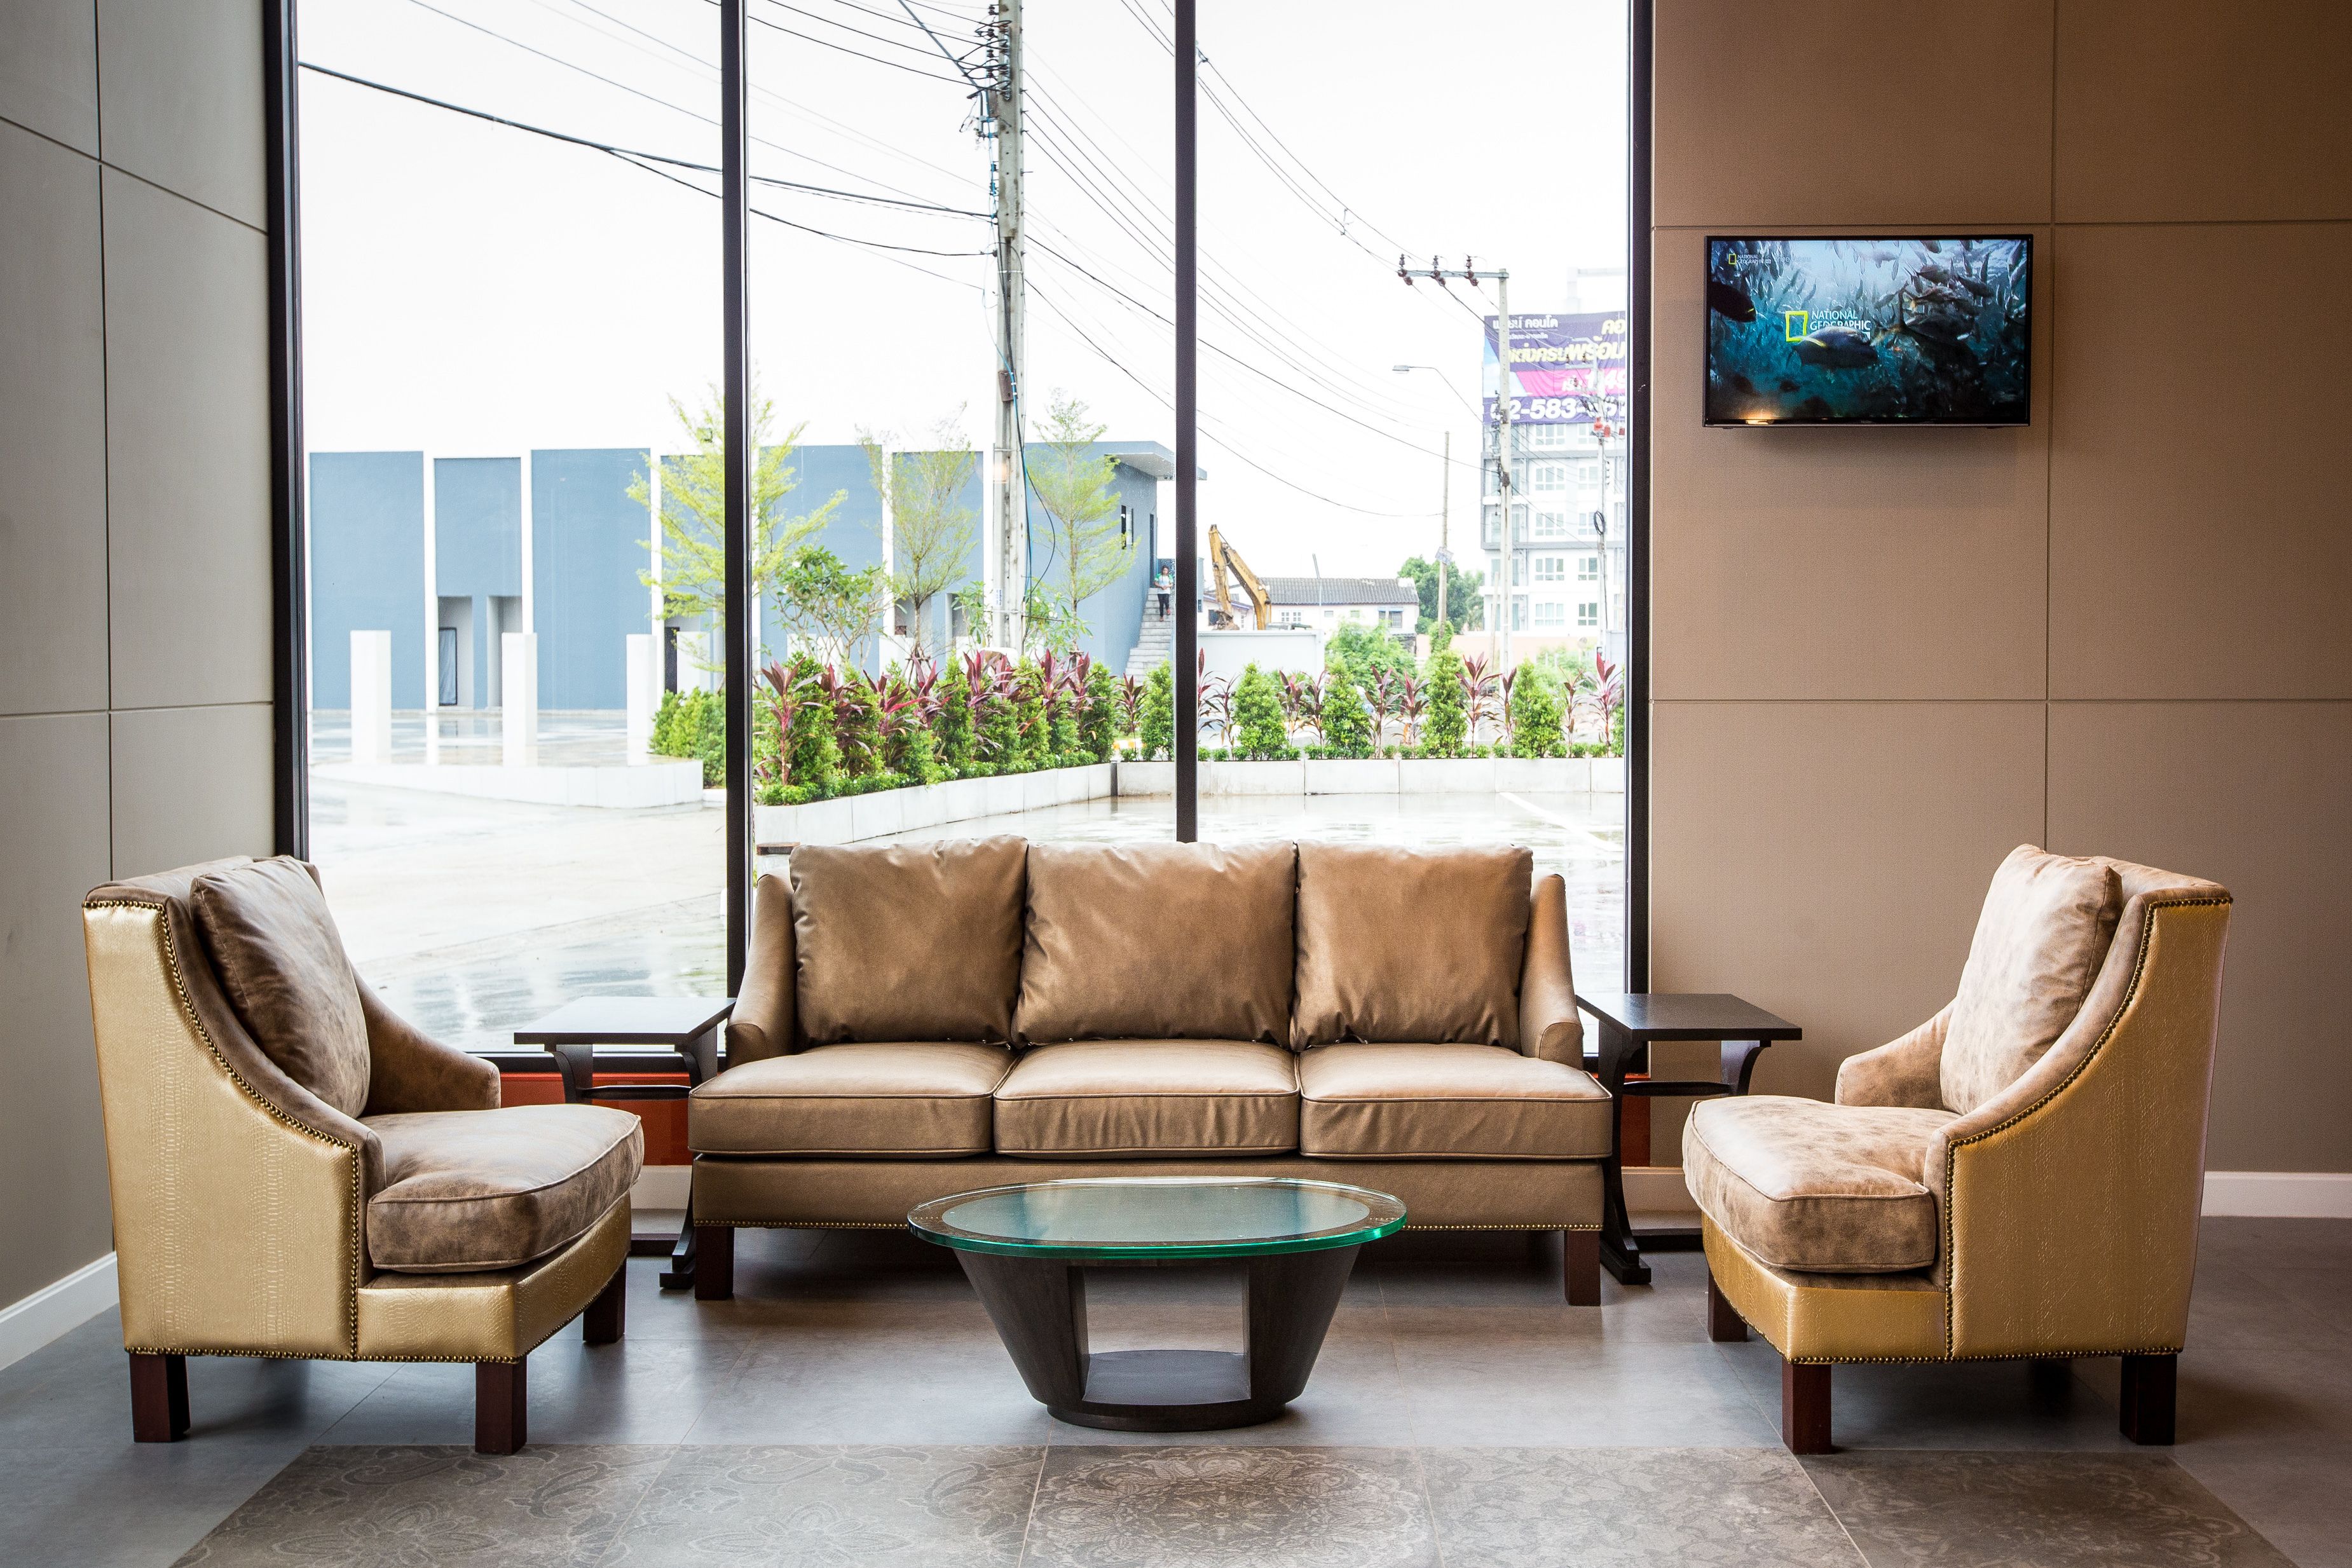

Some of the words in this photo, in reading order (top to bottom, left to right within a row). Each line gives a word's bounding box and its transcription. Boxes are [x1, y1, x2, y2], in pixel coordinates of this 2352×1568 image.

[1812, 310, 1858, 320] NATIONAL
[1525, 315, 1558, 329] คอนโด
[1810, 320, 1871, 331] GEOGRAPHIC
